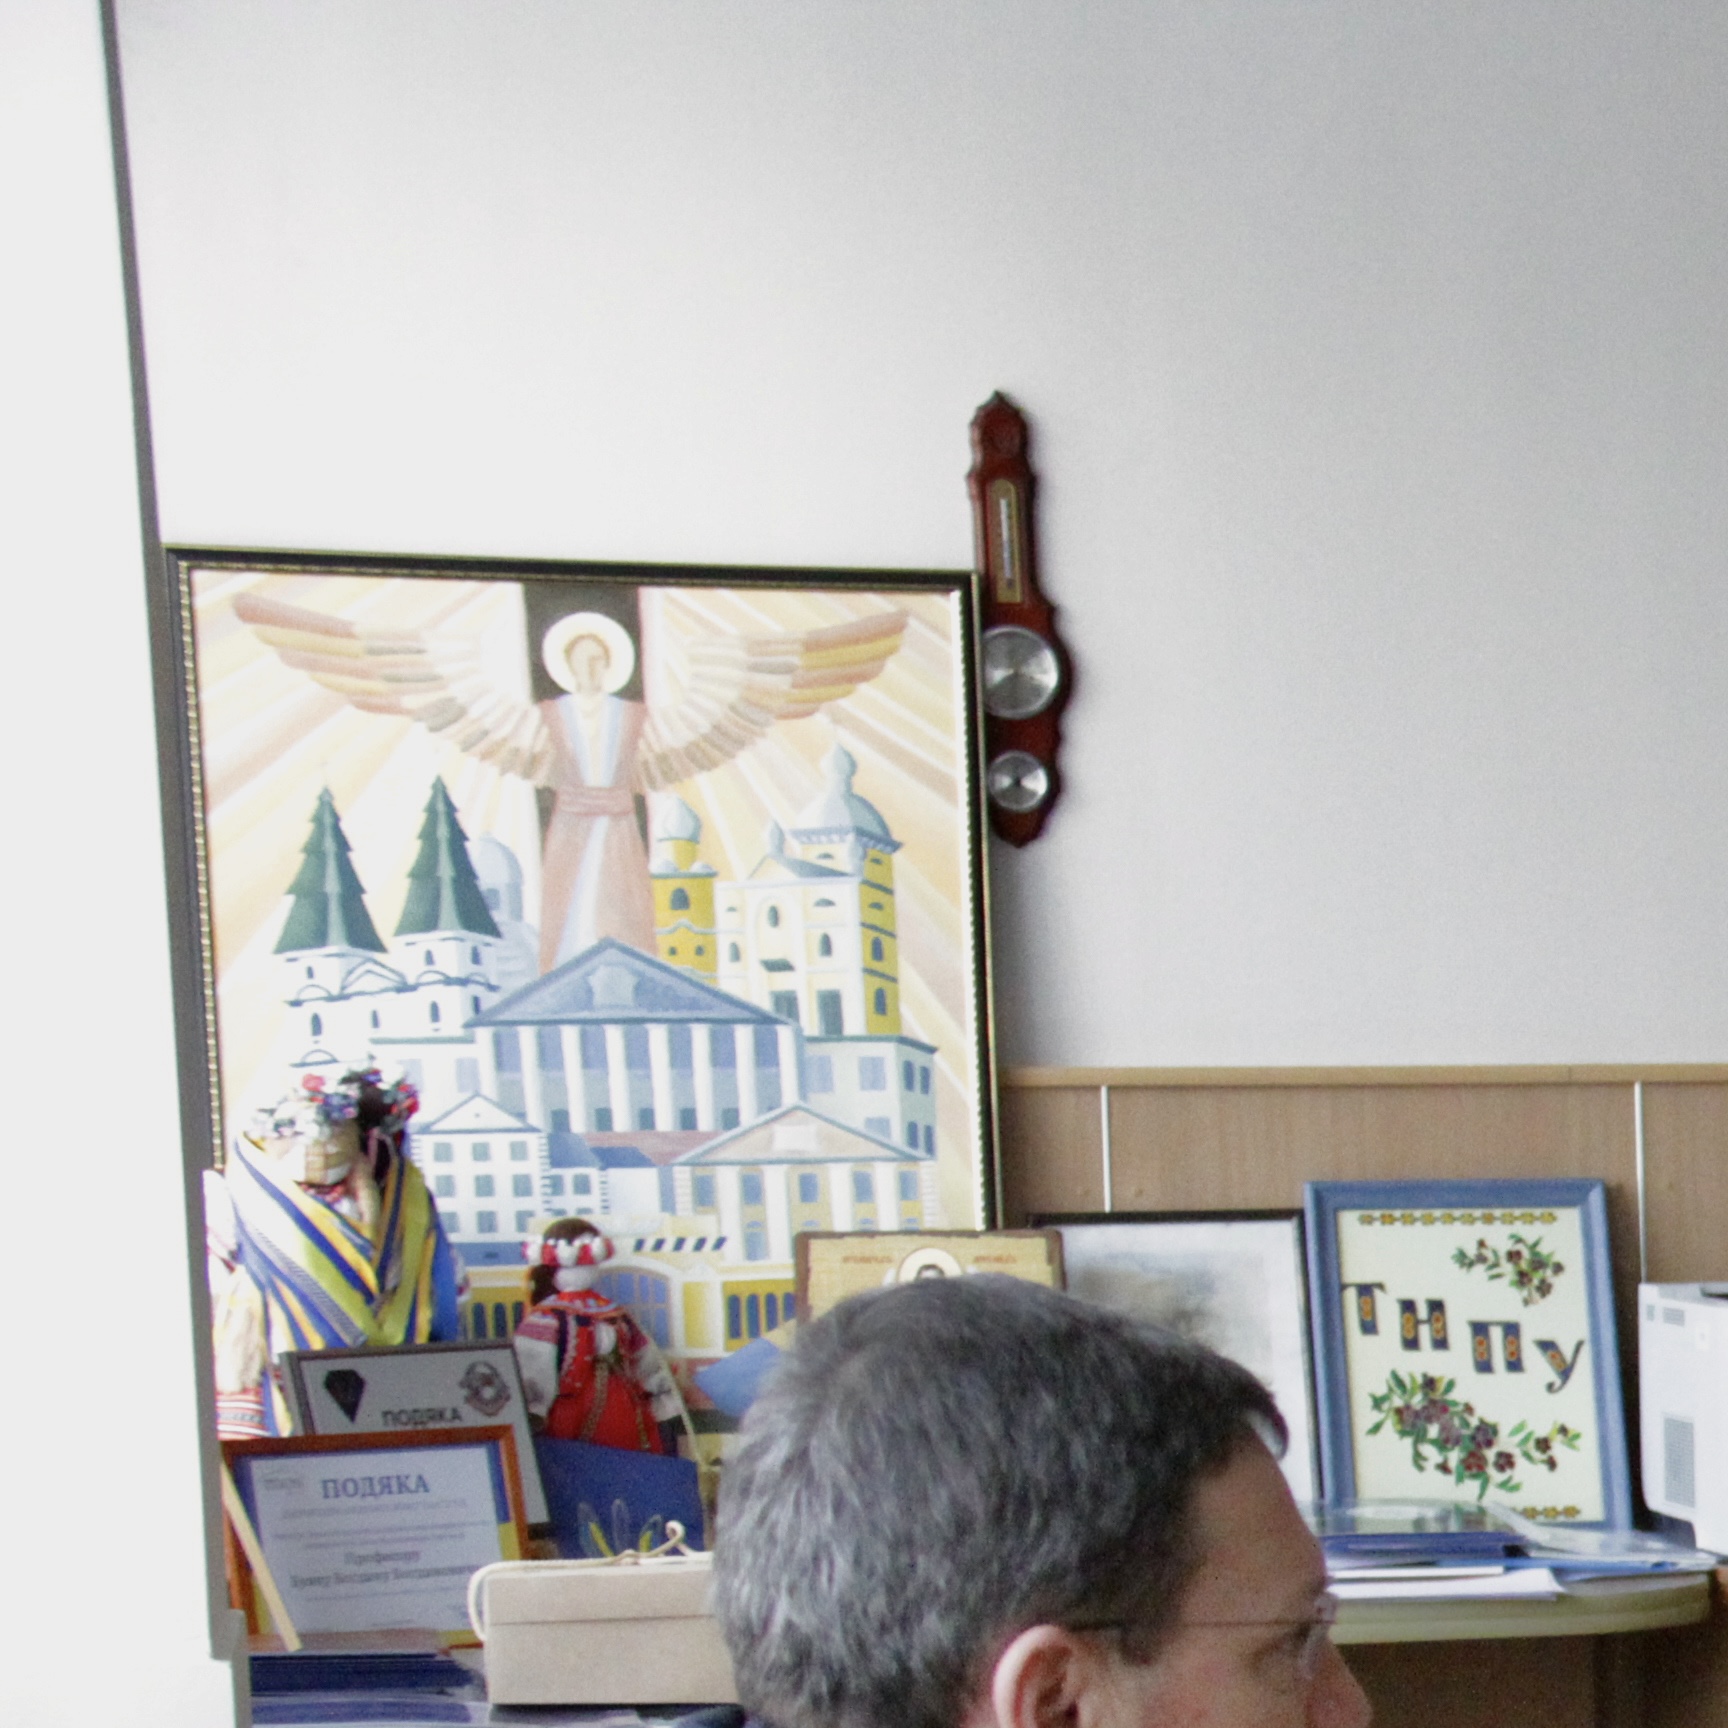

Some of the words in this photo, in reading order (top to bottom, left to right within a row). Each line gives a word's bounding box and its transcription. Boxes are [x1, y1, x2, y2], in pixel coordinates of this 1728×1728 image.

[1341, 1283, 1585, 1394] ТНПУ
[381, 1407, 463, 1427] ПОДЯКА
[321, 1473, 431, 1500] ПОДЯКА
